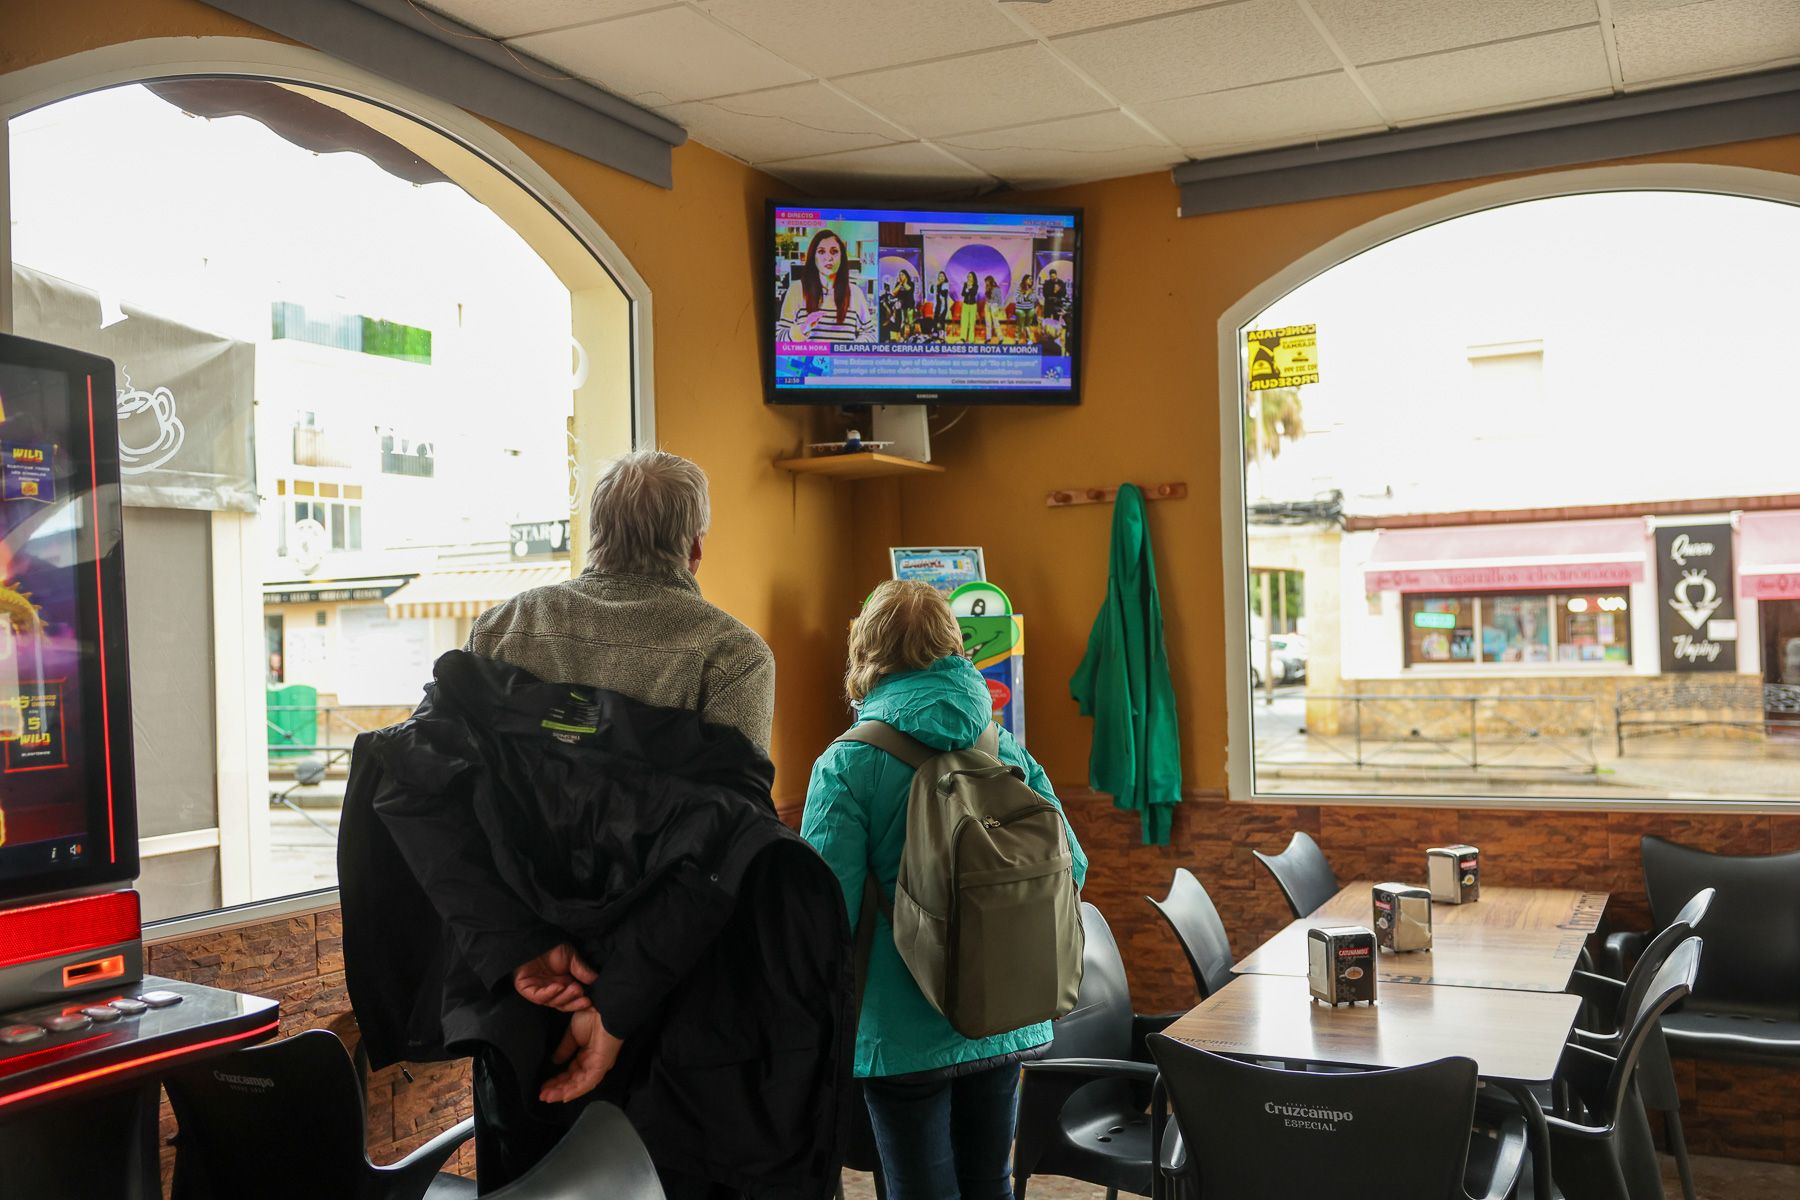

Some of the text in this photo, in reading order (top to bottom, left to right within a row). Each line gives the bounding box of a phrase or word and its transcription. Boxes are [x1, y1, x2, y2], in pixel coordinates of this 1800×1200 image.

[782, 343, 806, 351] ÚLTIMA
[833, 344, 870, 352] BELARRA
[925, 345, 940, 353] LAS
[941, 345, 967, 353] BASES
[1009, 344, 1038, 354] MORÓN
[12, 447, 44, 462] WILD
[1671, 534, 1715, 566] Queen
[1672, 633, 1722, 663] Vaping
[20, 732, 51, 746] WILD
[213, 1069, 275, 1089] Cruzcampo
[1264, 1101, 1354, 1122] Cruzcampo
[1284, 1118, 1337, 1132] ESPECIAL
